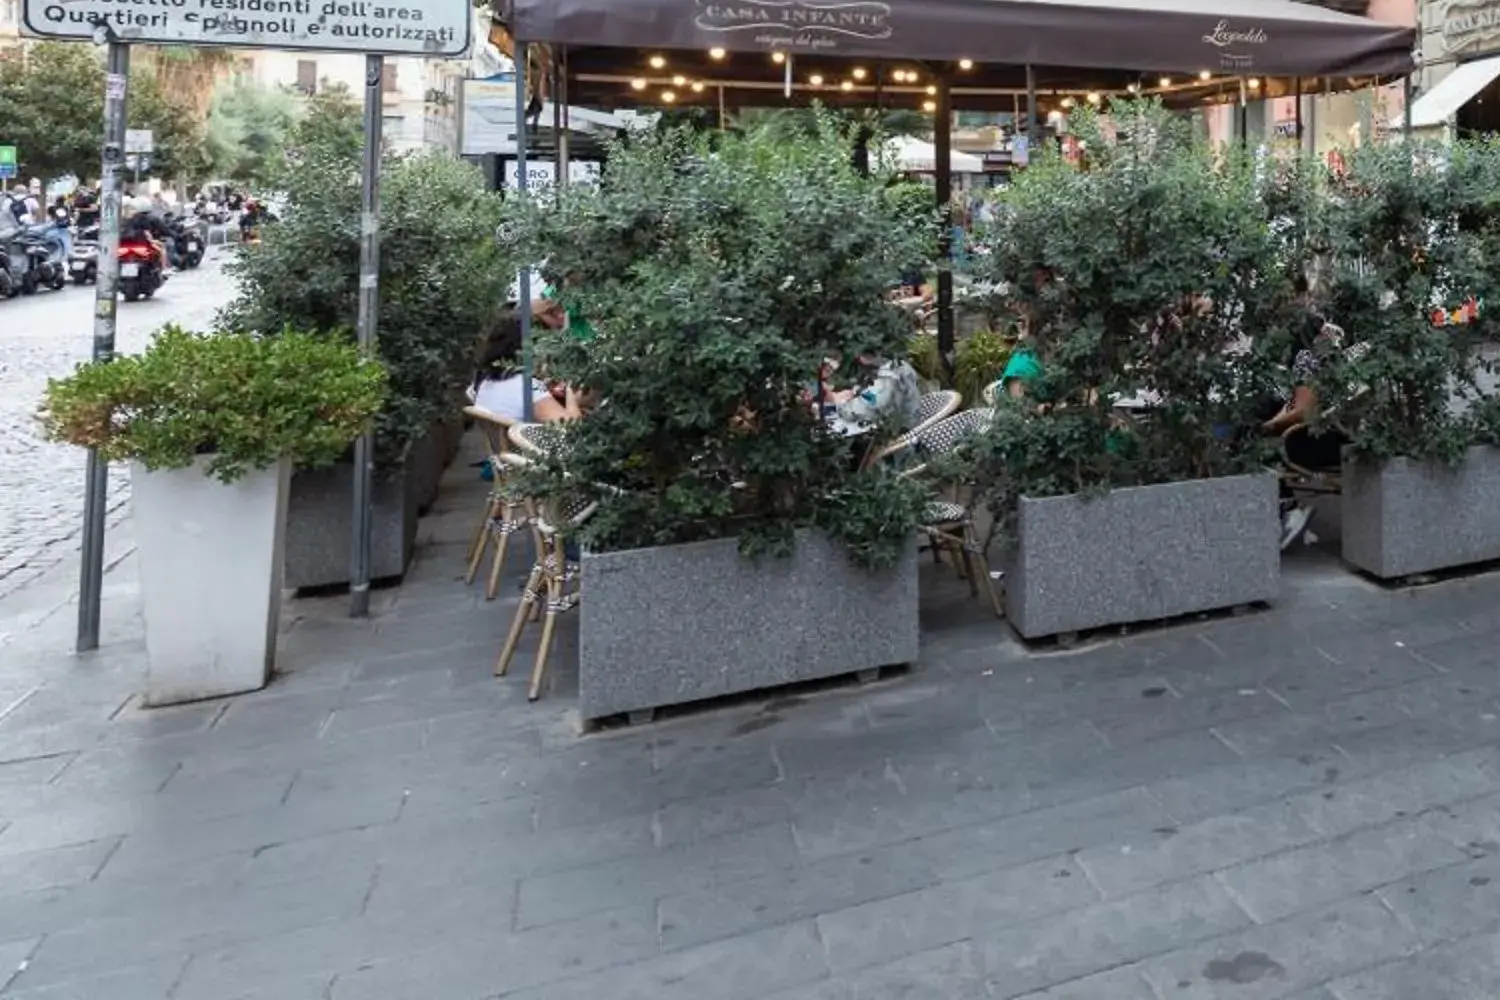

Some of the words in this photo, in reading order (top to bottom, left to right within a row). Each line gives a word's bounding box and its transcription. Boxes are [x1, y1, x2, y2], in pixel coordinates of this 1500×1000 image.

[322, 0, 423, 21] dell'area
[706, 5, 769, 22] CASA
[781, 8, 885, 26] INFANTE
[44, 4, 168, 27] Quartieri
[185, 12, 295, 35] Spgnoli
[307, 20, 321, 35] e
[331, 22, 454, 42] autorizzati
